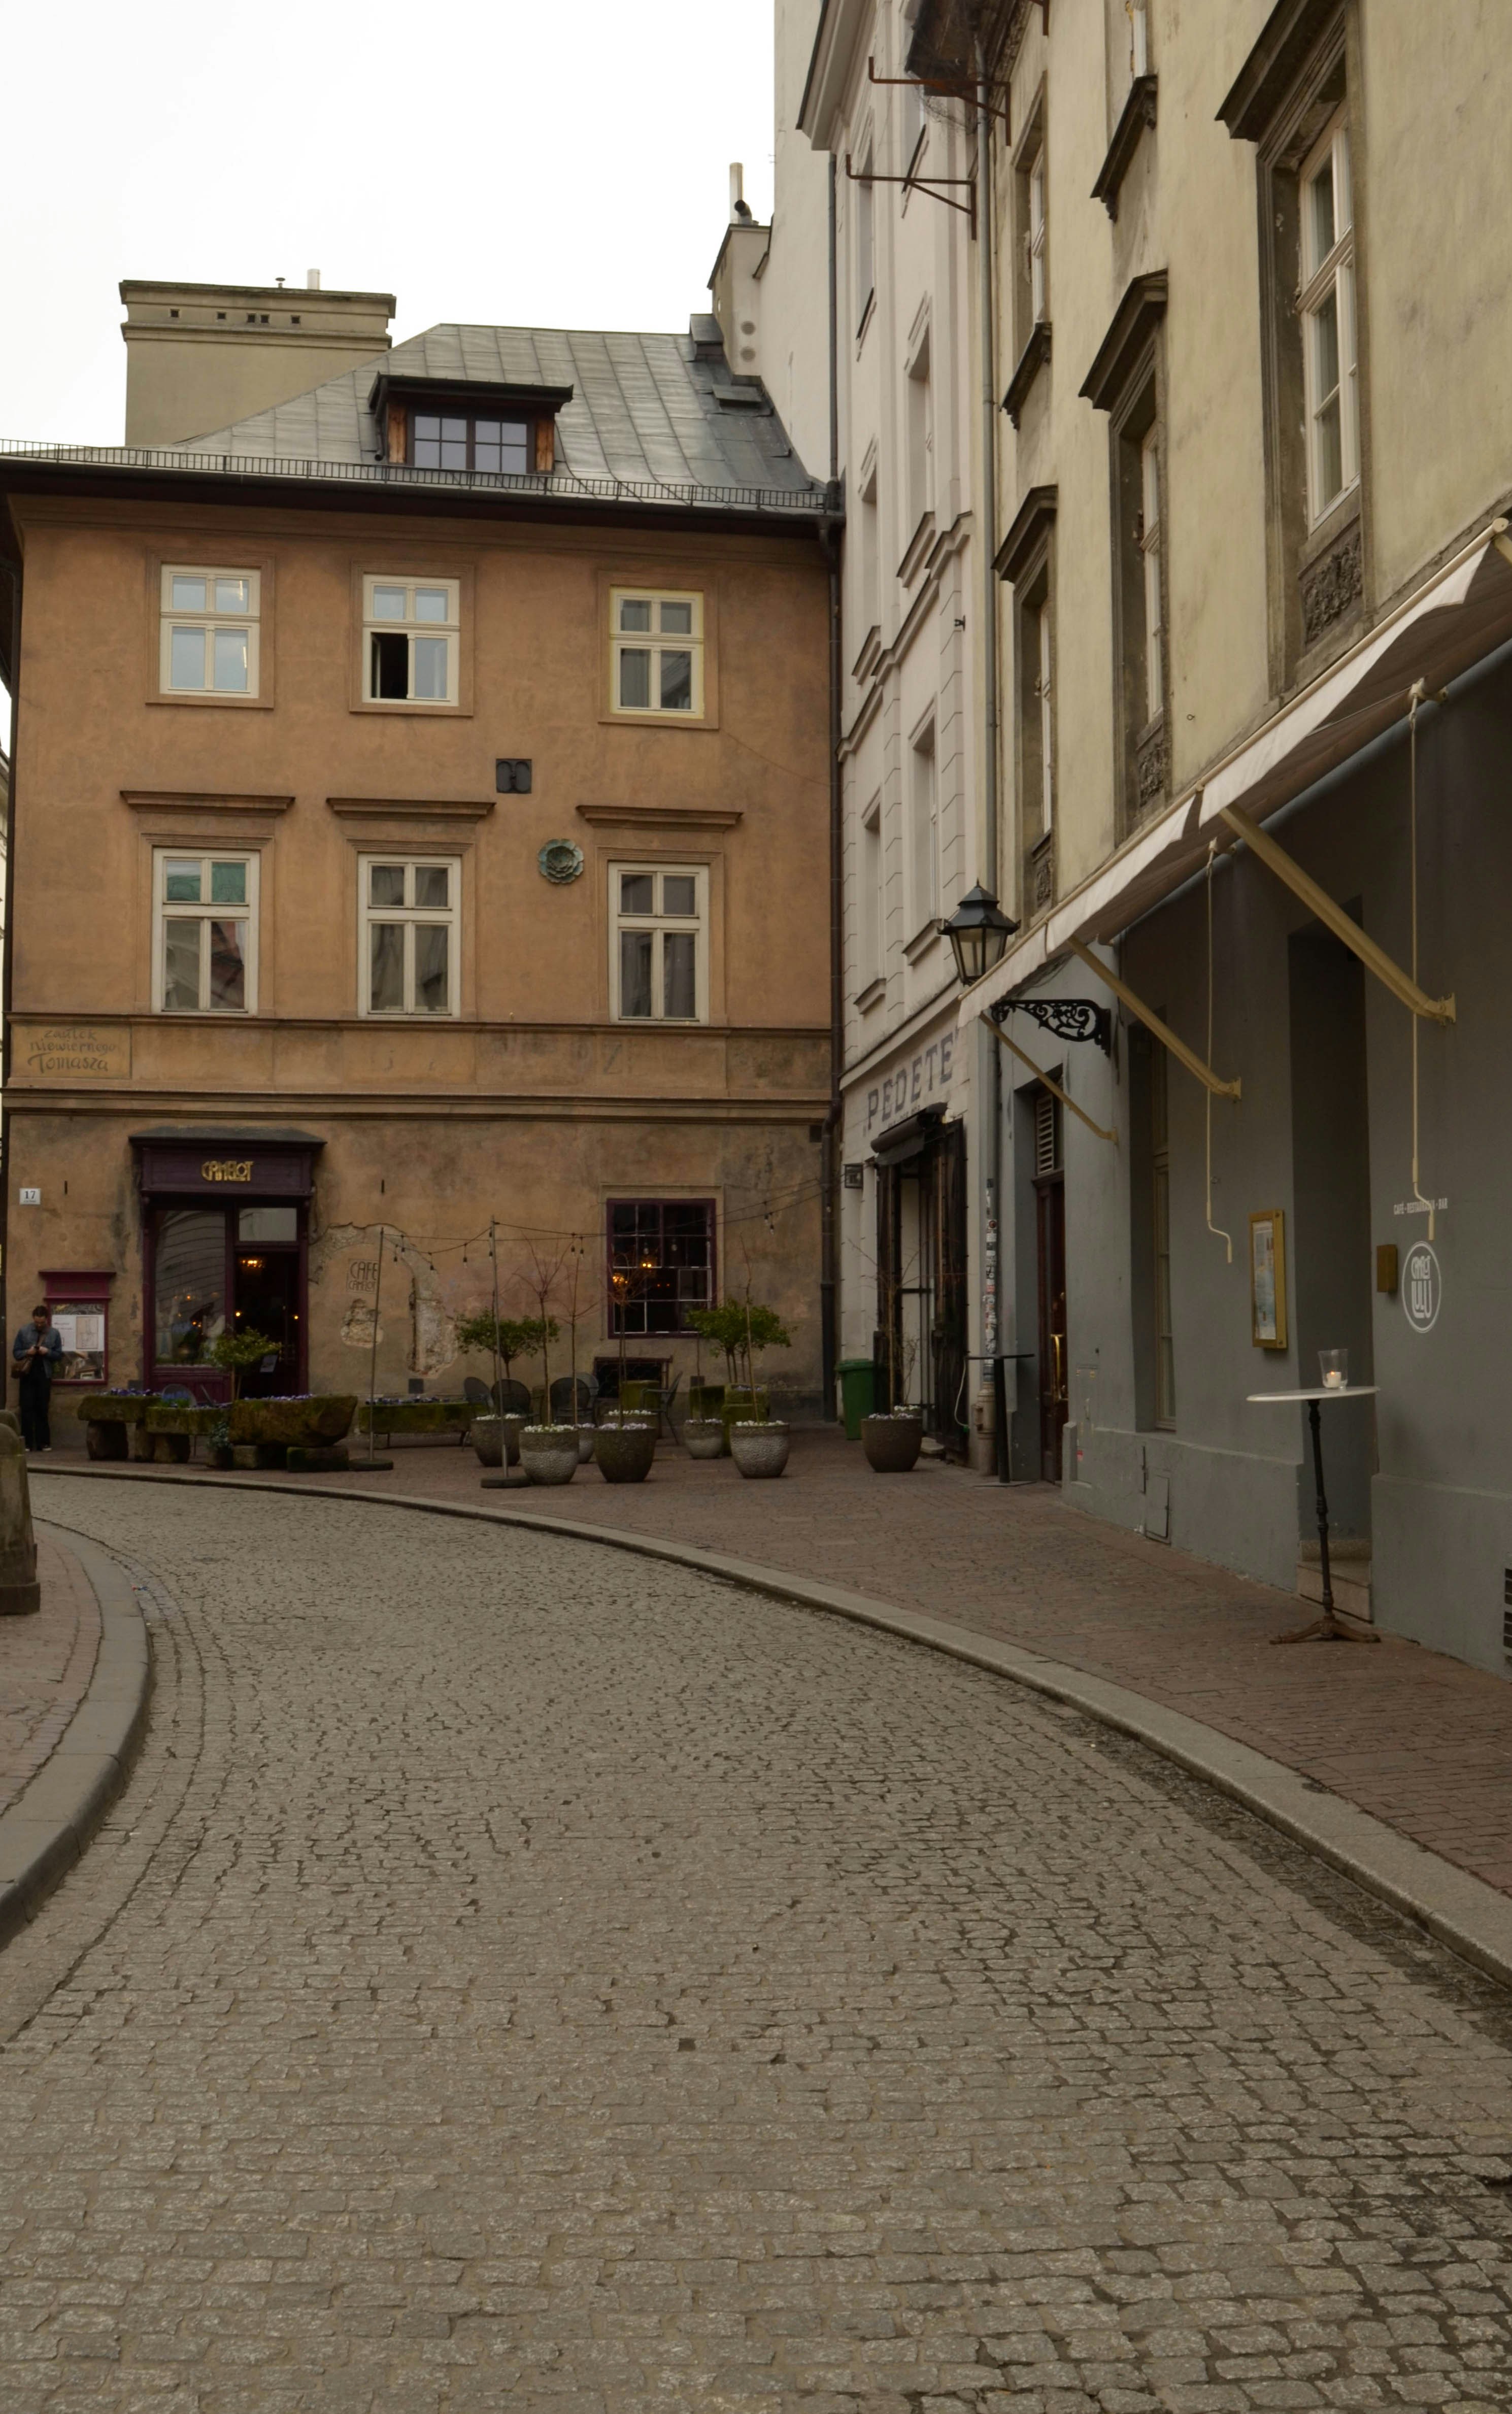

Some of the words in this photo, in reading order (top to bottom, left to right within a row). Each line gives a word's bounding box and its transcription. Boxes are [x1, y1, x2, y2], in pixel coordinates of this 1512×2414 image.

[27, 1052, 109, 1074] Tomasza
[201, 1161, 254, 1182] CAMELOT
[24, 1190, 36, 1199] 17
